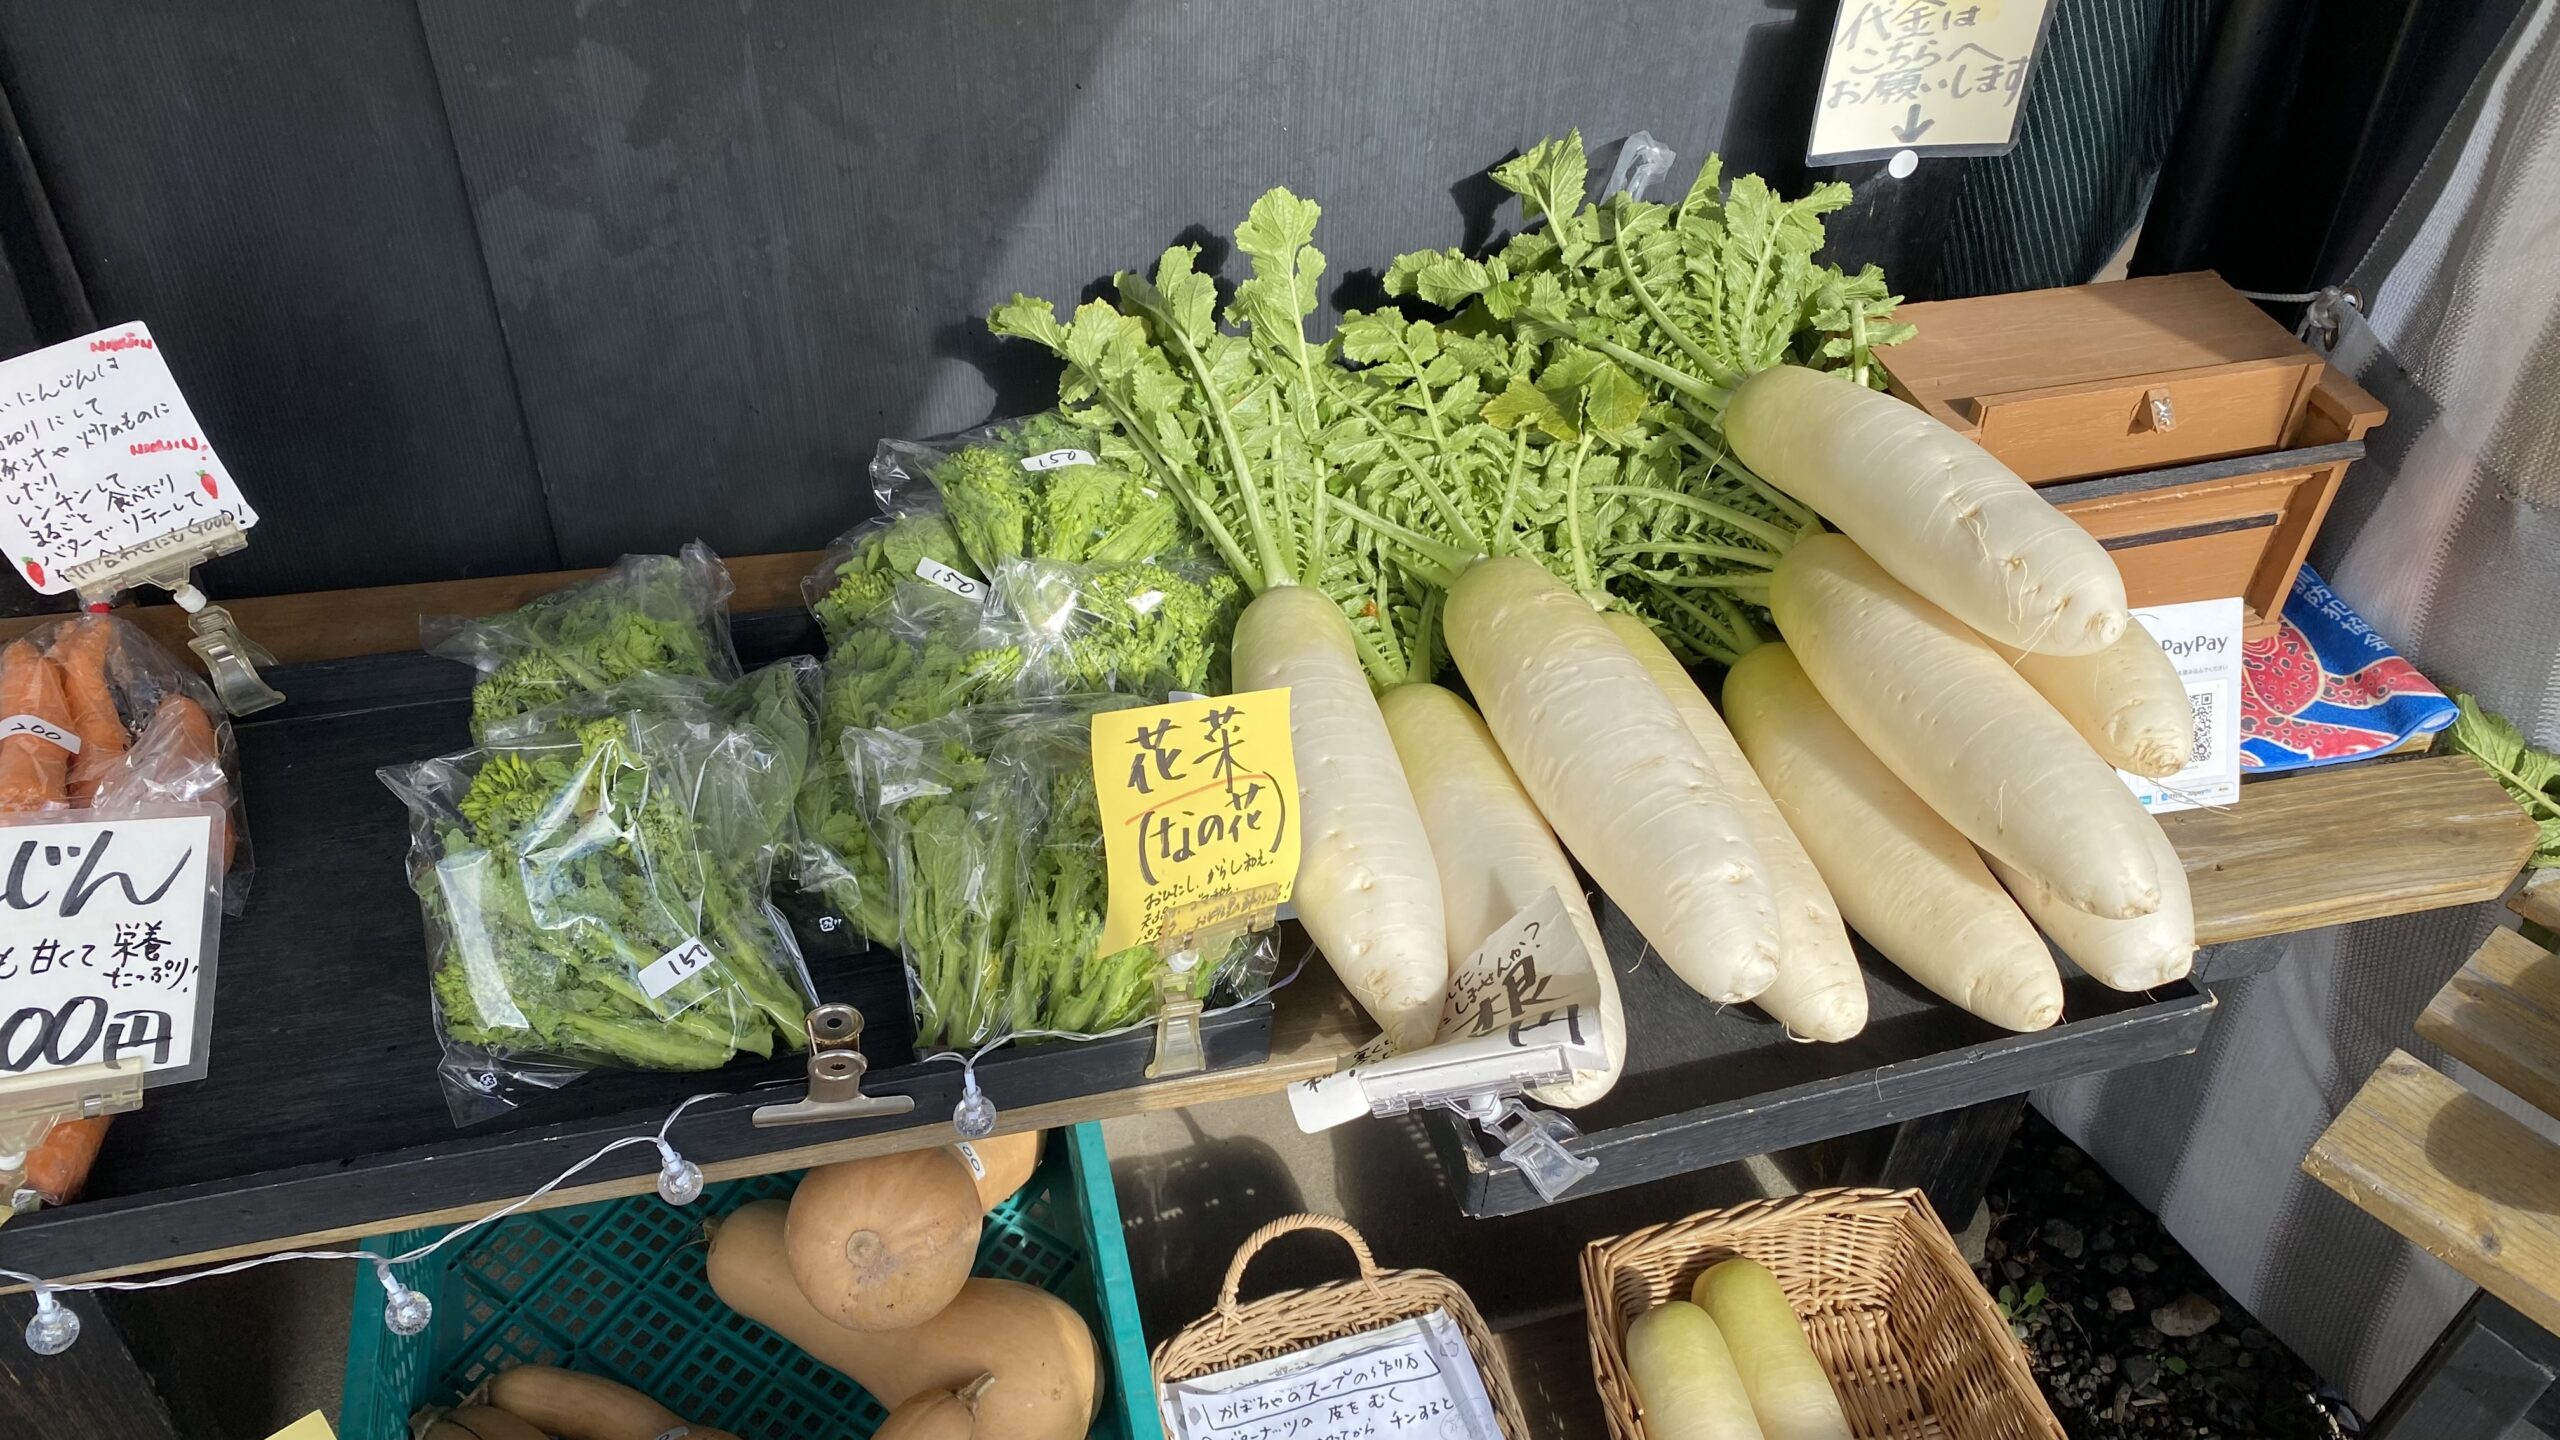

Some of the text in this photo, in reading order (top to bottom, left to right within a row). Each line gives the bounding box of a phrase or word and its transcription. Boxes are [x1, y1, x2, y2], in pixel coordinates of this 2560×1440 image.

[1837, 0, 1980, 51] 代金は
[1849, 40, 2004, 75] こちらへ
[1826, 56, 2029, 110] お願いします
[1038, 450, 1077, 468] 150
[932, 568, 976, 594] 150
[2161, 635, 2229, 658] PayPay
[1125, 705, 1253, 794] 花菜
[0, 830, 193, 917] じん
